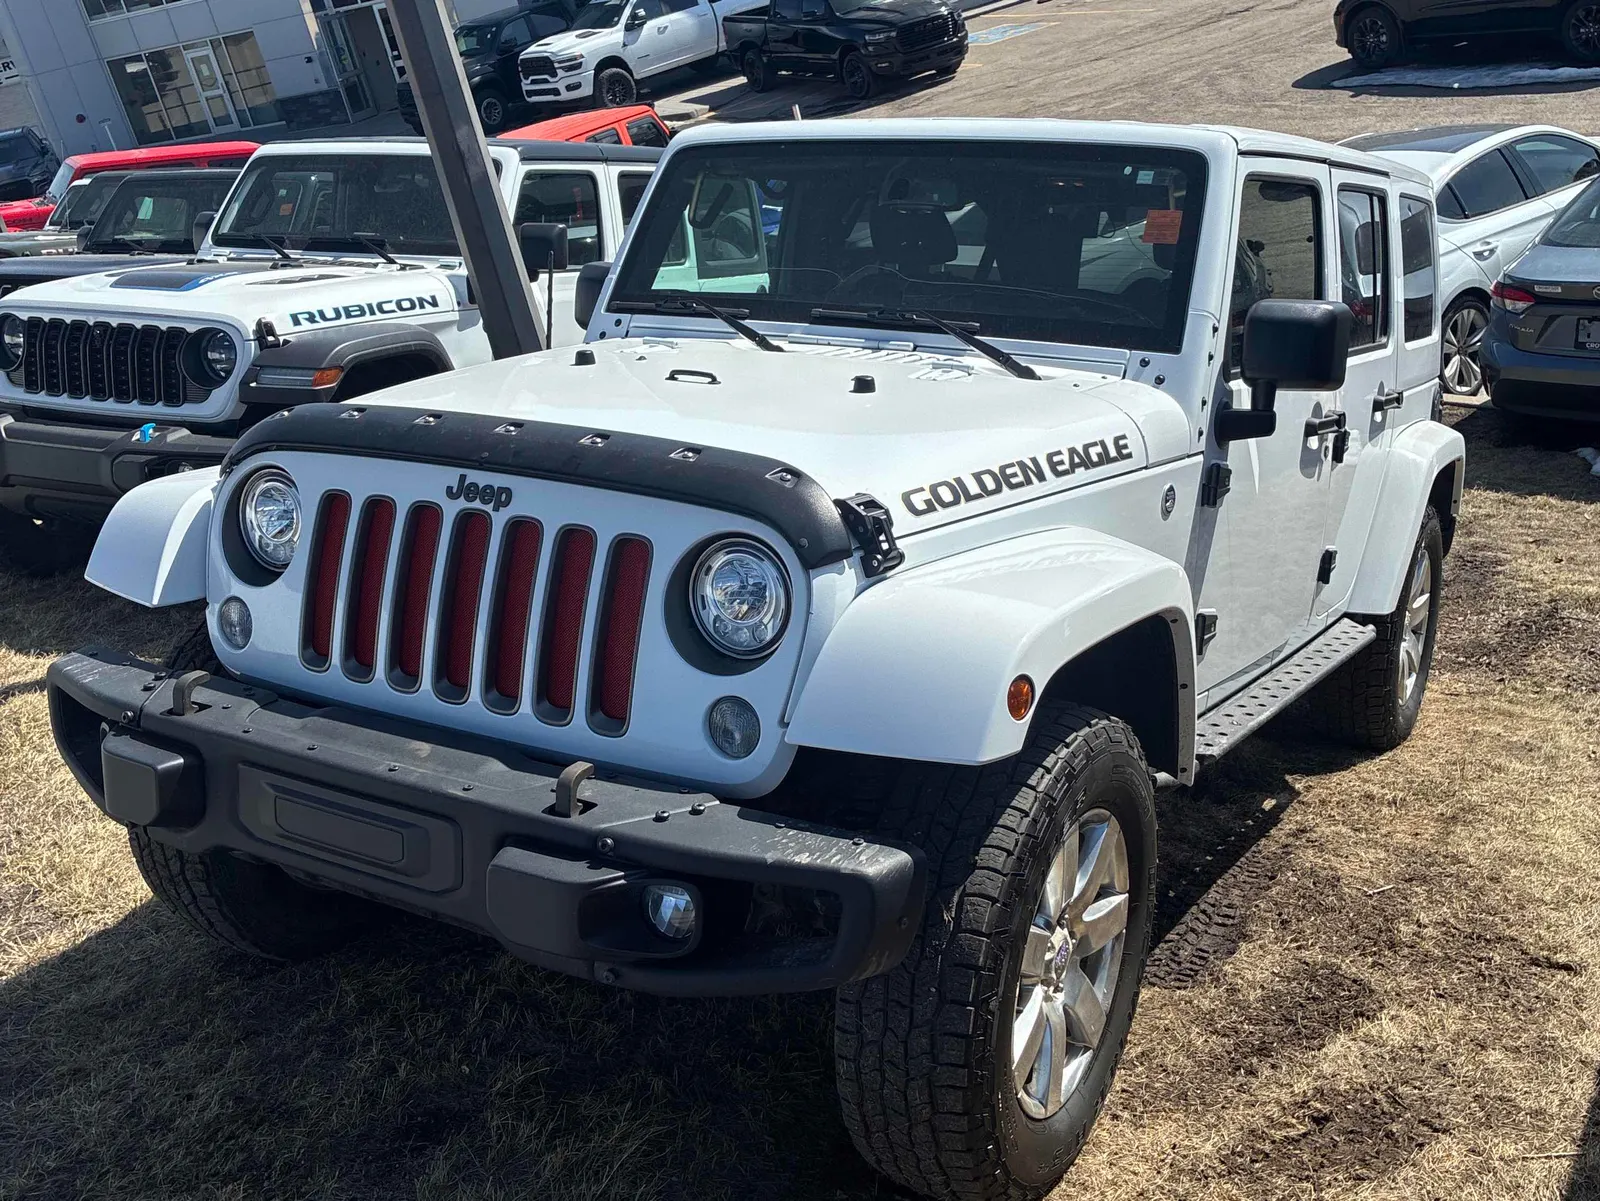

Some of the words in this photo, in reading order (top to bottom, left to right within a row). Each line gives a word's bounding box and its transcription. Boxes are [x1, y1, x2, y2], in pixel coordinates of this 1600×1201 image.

[289, 295, 439, 327] RUBICON
[446, 474, 512, 512] Jeep
[901, 456, 1048, 517] GOLDEN
[1046, 433, 1133, 478] EAGLE
